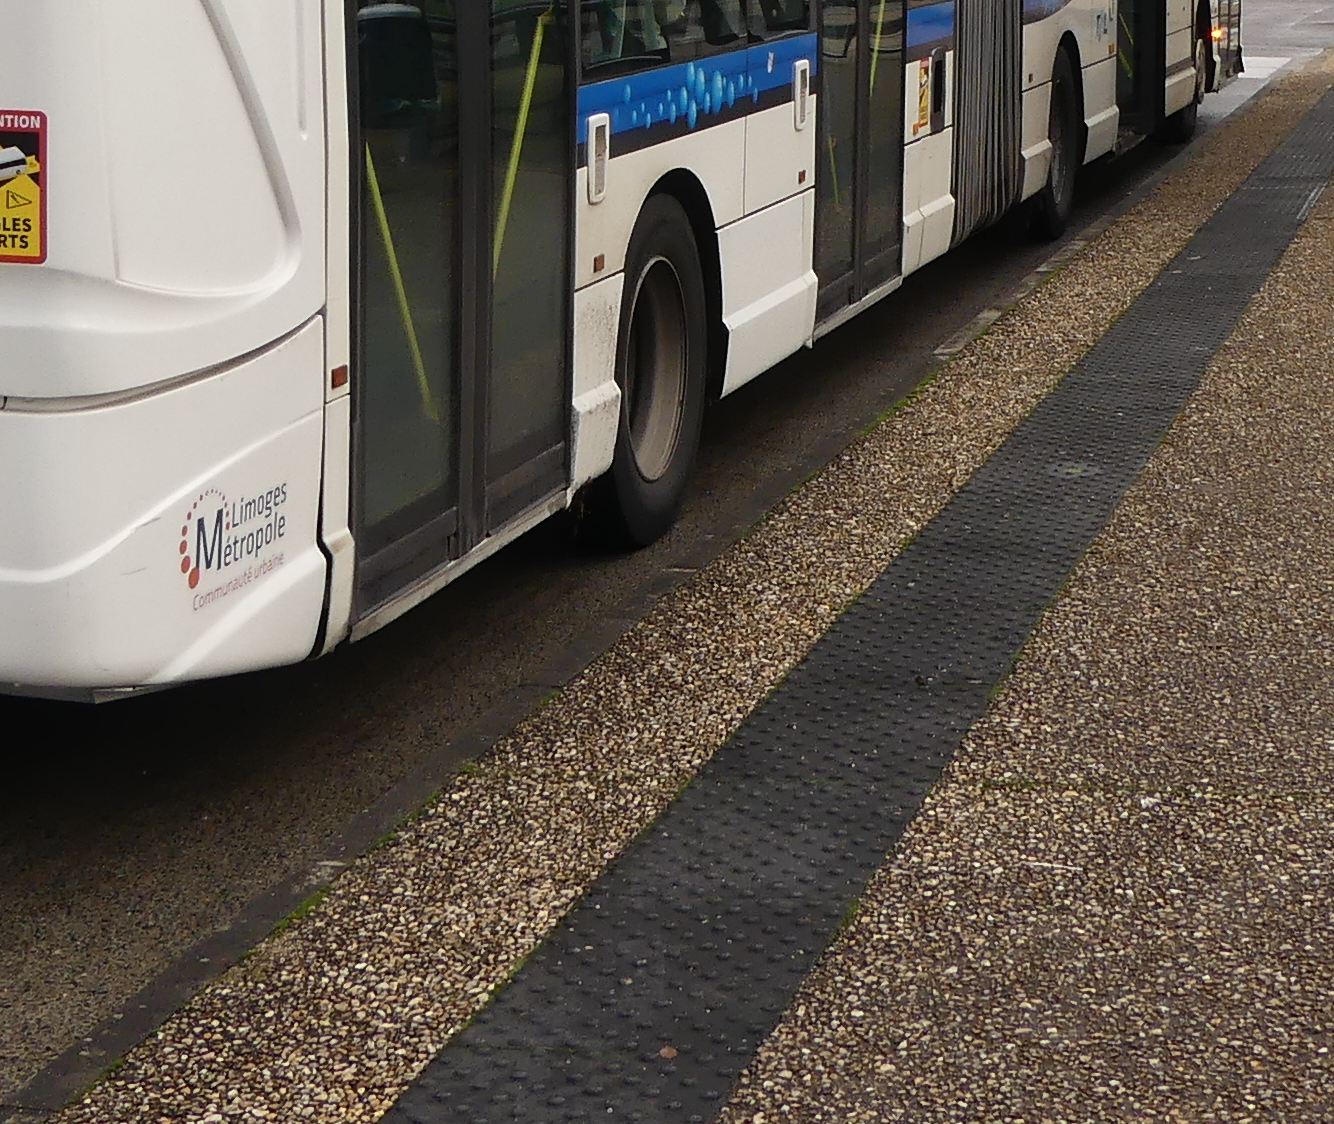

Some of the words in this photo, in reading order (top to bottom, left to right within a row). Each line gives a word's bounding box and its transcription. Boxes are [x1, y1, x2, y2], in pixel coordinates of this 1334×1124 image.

[232, 483, 287, 528] Limoges
[195, 507, 286, 570] Métropole
[193, 566, 253, 611] Communauté
[254, 553, 285, 579] urbaine
